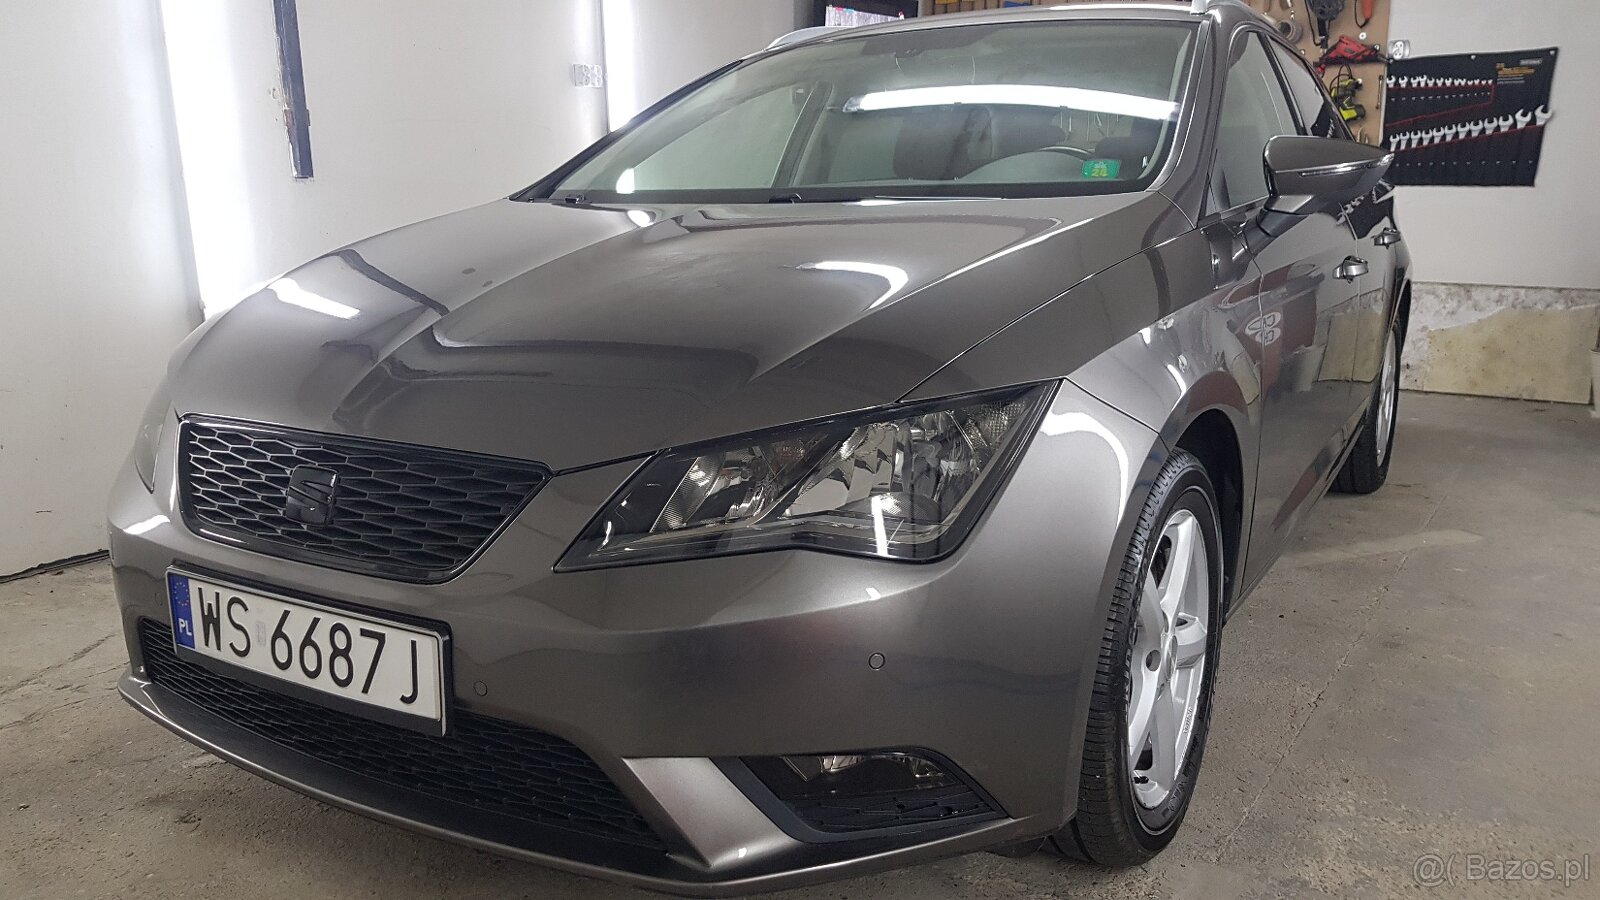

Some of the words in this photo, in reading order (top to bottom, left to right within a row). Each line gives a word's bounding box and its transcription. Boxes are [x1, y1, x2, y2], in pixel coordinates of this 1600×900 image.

[178, 618, 192, 636] PL
[198, 587, 250, 657] WS
[271, 609, 419, 704] 6687J
